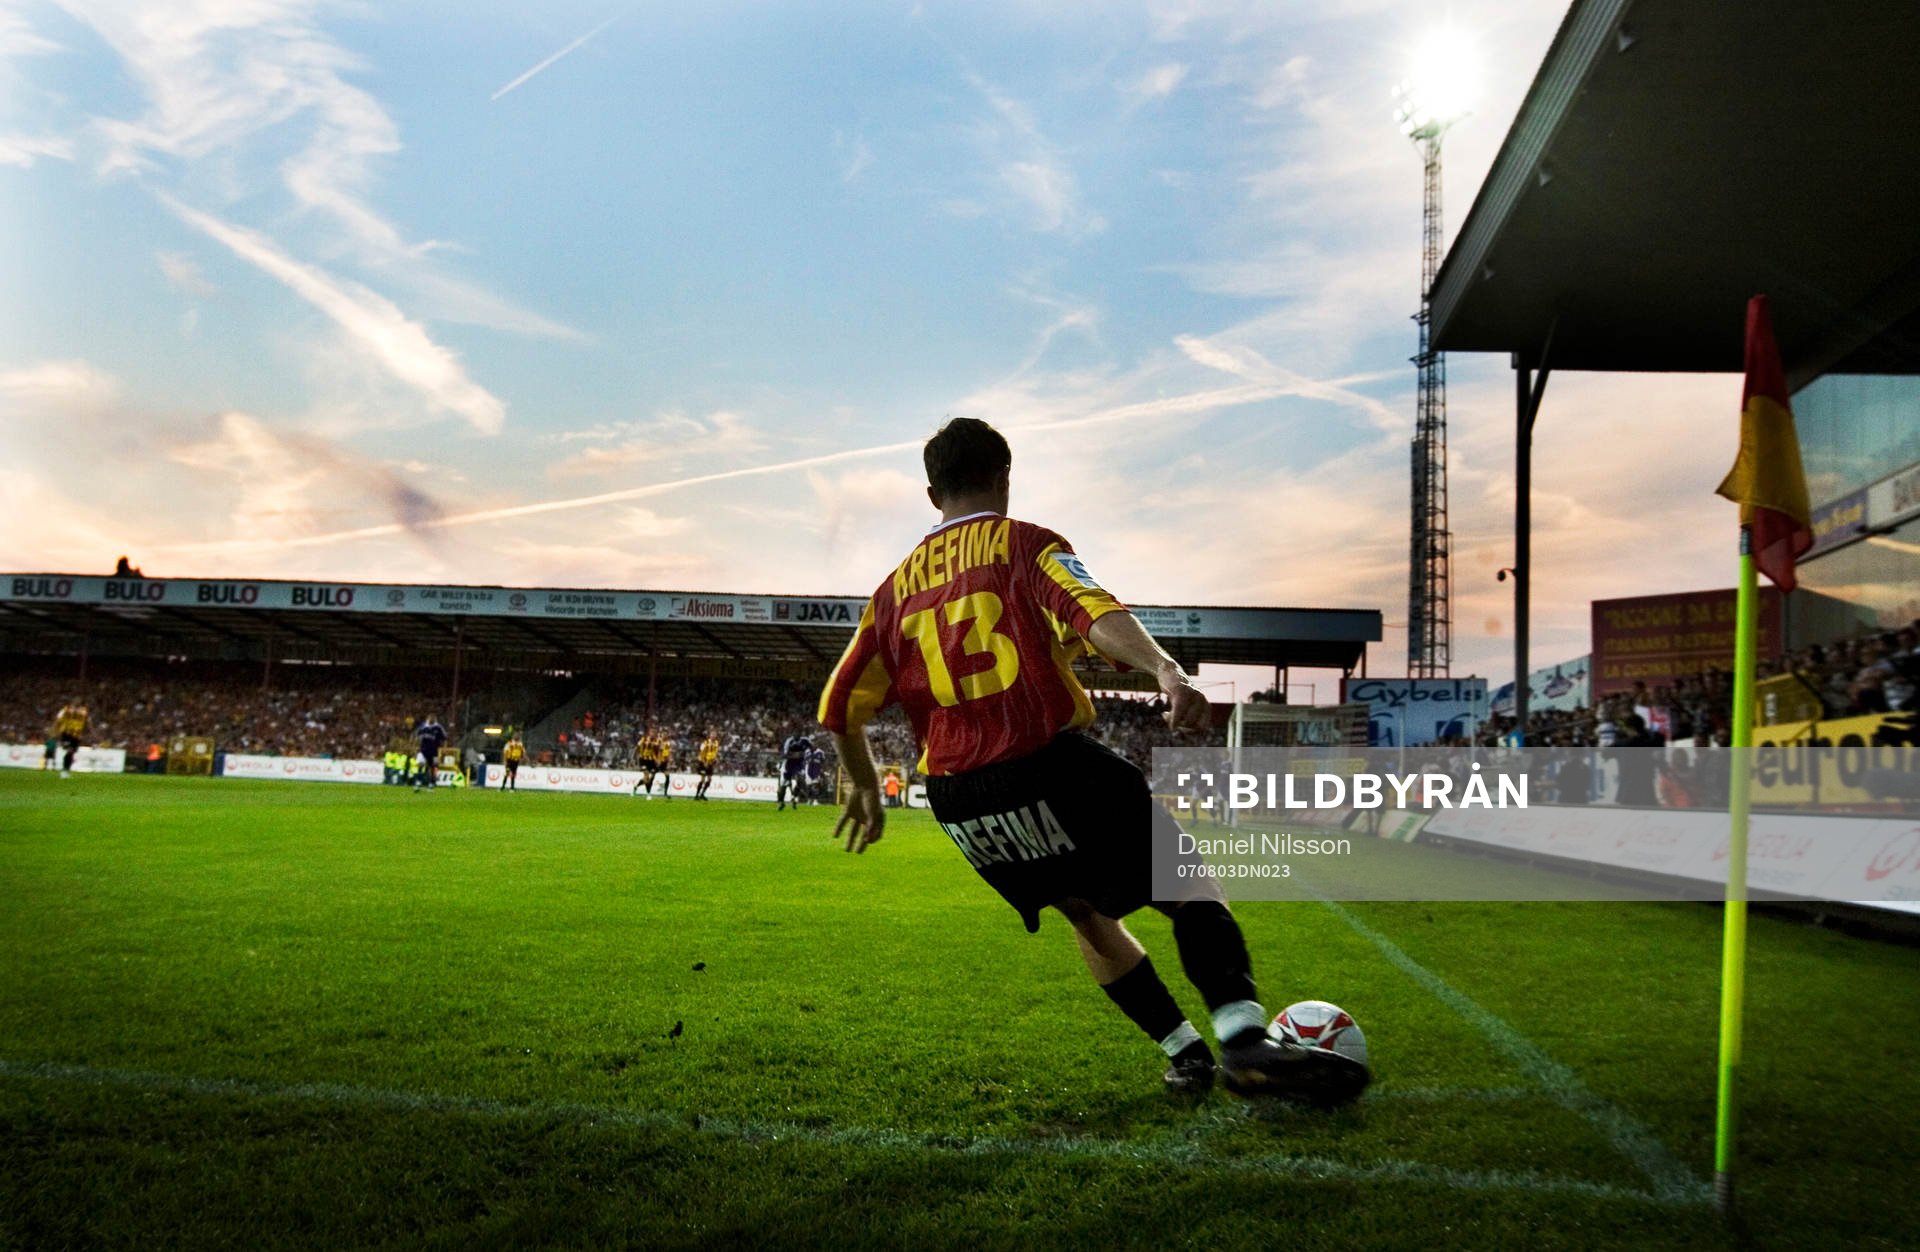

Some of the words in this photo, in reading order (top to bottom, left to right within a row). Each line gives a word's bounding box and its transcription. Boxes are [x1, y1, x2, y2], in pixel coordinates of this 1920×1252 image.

[12, 578, 73, 598] BULO
[104, 581, 165, 601] BULO
[197, 583, 260, 604] BULO
[291, 586, 354, 607] BULO
[686, 599, 734, 618] Aksioma
[796, 602, 851, 622] JAVA
[901, 591, 1019, 707] 13
[1351, 680, 1483, 707] Gybels
[562, 775, 599, 784] VEOLIA
[941, 800, 1077, 869] REFIMA
